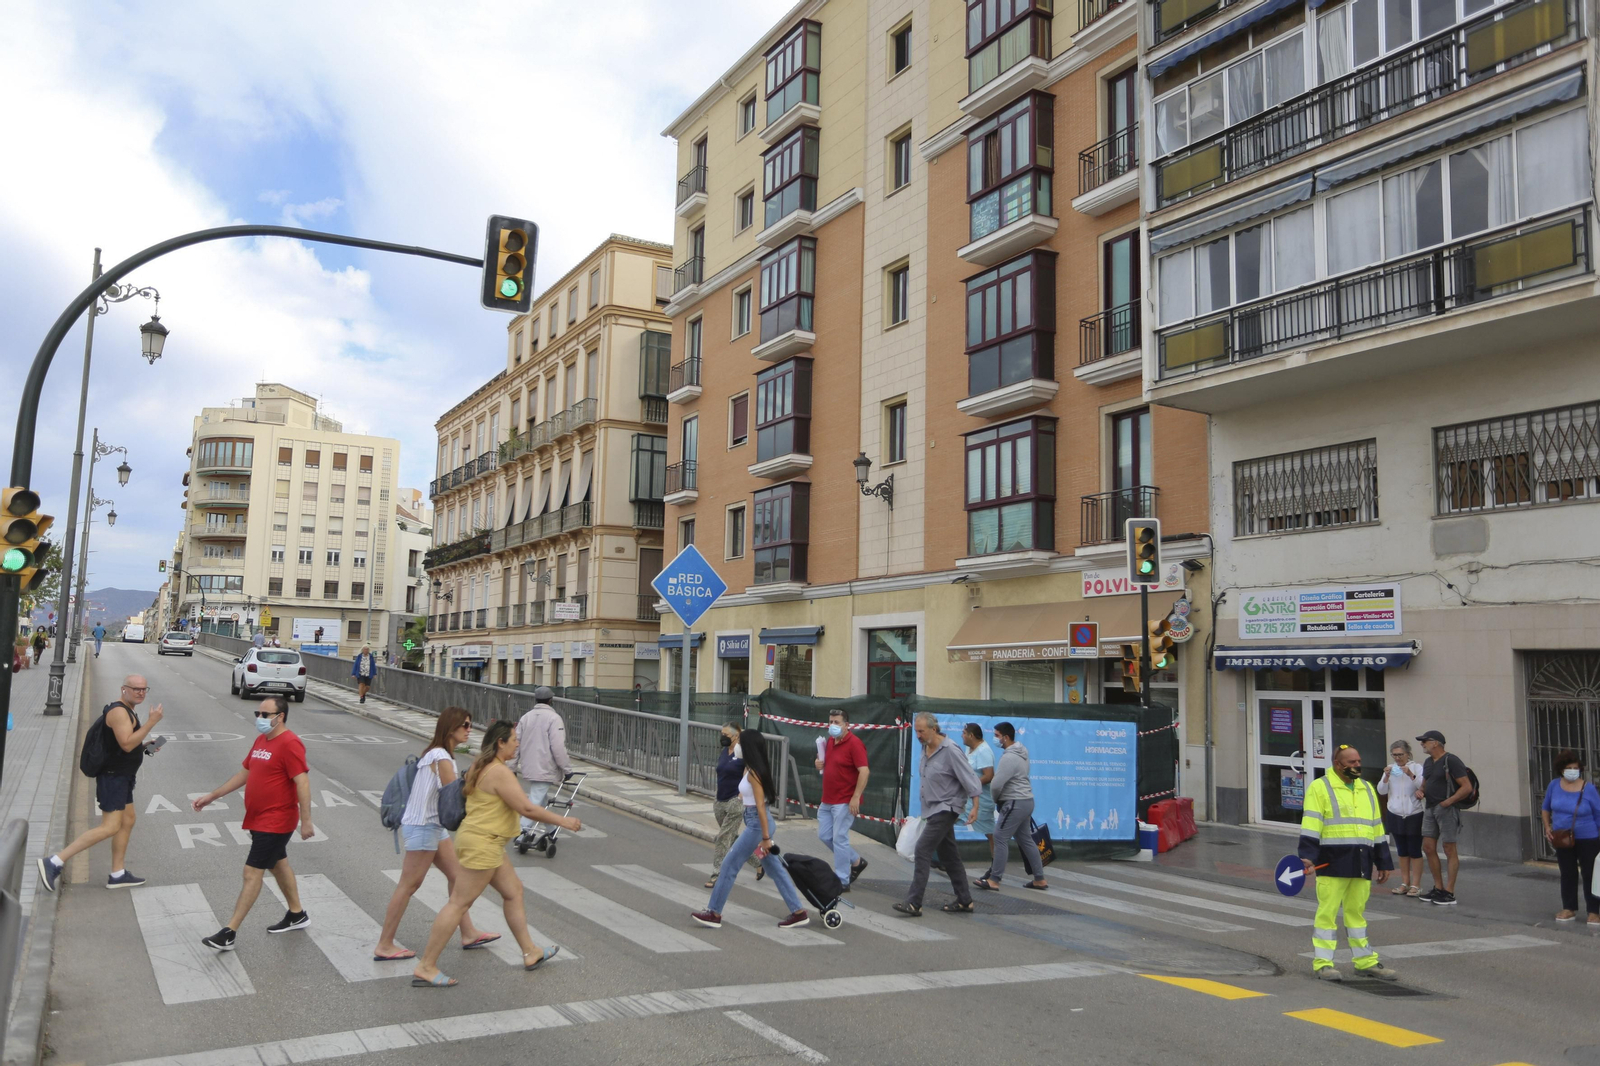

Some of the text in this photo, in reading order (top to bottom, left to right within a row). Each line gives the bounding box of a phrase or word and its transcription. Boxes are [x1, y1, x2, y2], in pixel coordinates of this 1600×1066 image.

[678, 573, 703, 584] RED
[667, 584, 713, 598] BÁSICA
[1084, 577, 1159, 595] POLVI
[1354, 591, 1385, 599] Cartelería
[1301, 604, 1326, 612] Impresión
[1169, 626, 1191, 638] OLVILLO
[1245, 622, 1297, 634] 952 215 237
[1307, 624, 1339, 632] Rotulación
[726, 639, 749, 649] Silvia Gil
[993, 647, 1036, 659] PANADERÍA
[1225, 656, 1388, 667] IMPRENTA GASTRO
[251, 749, 273, 761] adidas
[1085, 746, 1127, 755] HORMACESA
